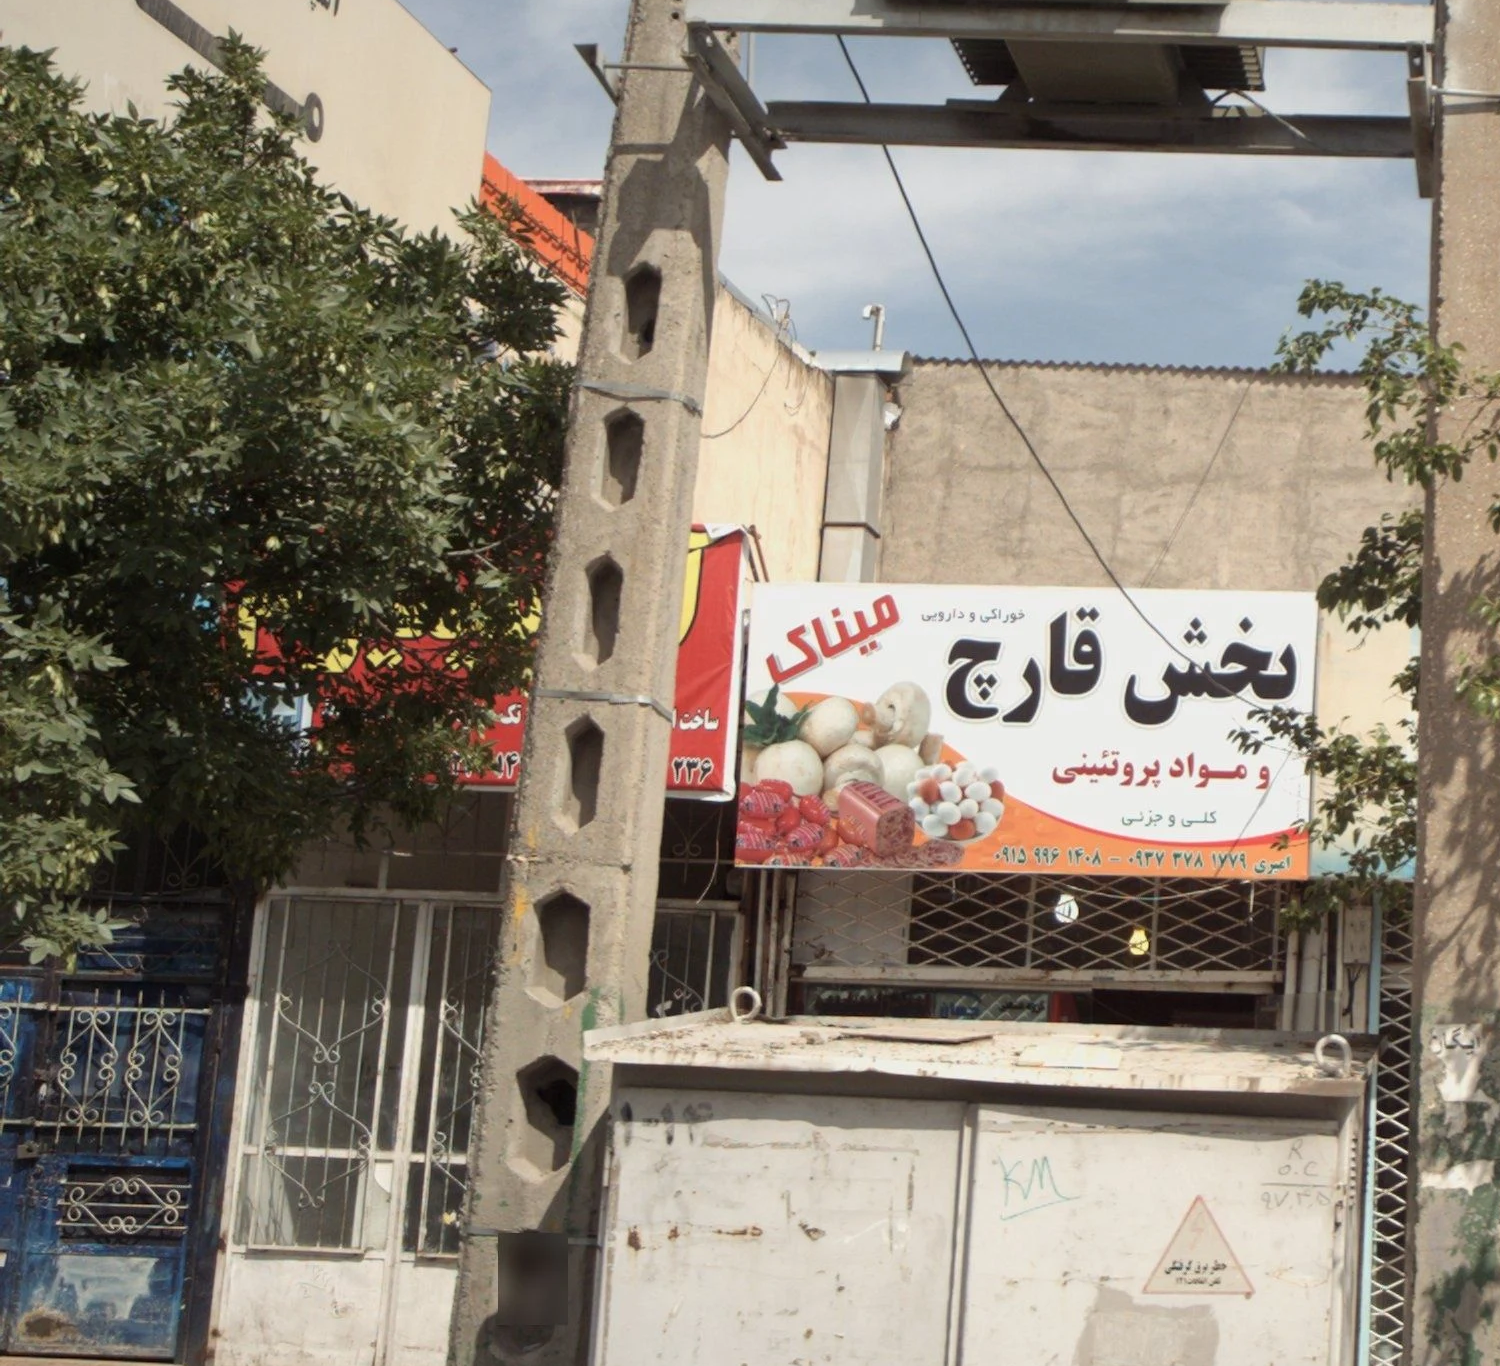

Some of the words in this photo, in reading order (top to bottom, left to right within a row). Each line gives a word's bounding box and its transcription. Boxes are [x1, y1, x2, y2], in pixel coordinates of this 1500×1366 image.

[921, 607, 965, 623] دارویی
[969, 611, 976, 623] و
[979, 607, 1026, 624] خوراکی
[765, 594, 902, 685] میناک
[945, 606, 1102, 724] قارچ
[679, 707, 719, 730] ساخت
[1051, 749, 1162, 788] پروتئینی
[1168, 752, 1248, 789] مواد
[1256, 762, 1271, 790] و
[1168, 814, 1175, 827] و
[1181, 810, 1217, 827] کلی
[994, 845, 1028, 865] ۰۹۱۵
[1033, 846, 1061, 866] ۹۹۶
[1067, 847, 1103, 866] ۱۴۰۸
[1128, 849, 1166, 868] ۰۹۳۷
[1172, 850, 1204, 868] ۳۷۸
[1211, 851, 1248, 871] ۱۷۷۹
[1253, 855, 1292, 875] امیری
[1193, 1261, 1209, 1276] برق
[1211, 1259, 1228, 1276] خطر
